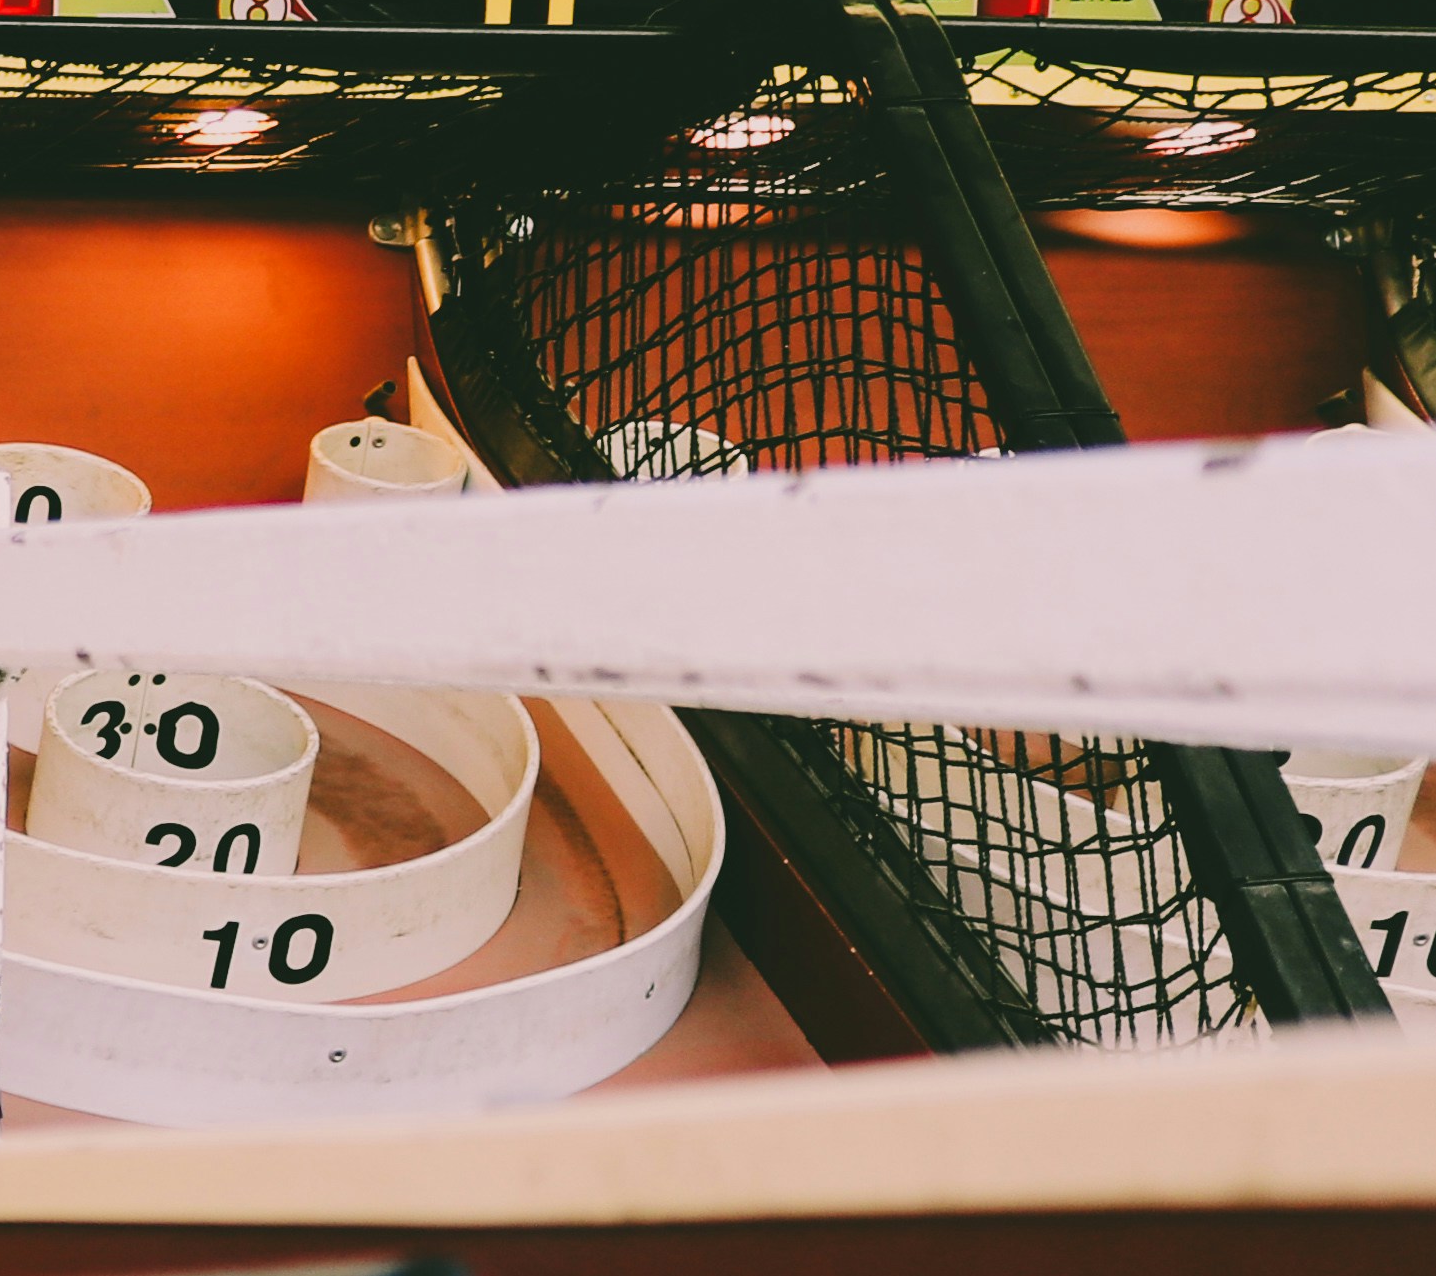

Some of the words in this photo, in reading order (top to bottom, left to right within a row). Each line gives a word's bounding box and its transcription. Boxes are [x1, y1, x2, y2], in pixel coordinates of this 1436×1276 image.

[81, 699, 221, 770] 30
[144, 822, 261, 874] 20
[202, 913, 335, 990] 10
